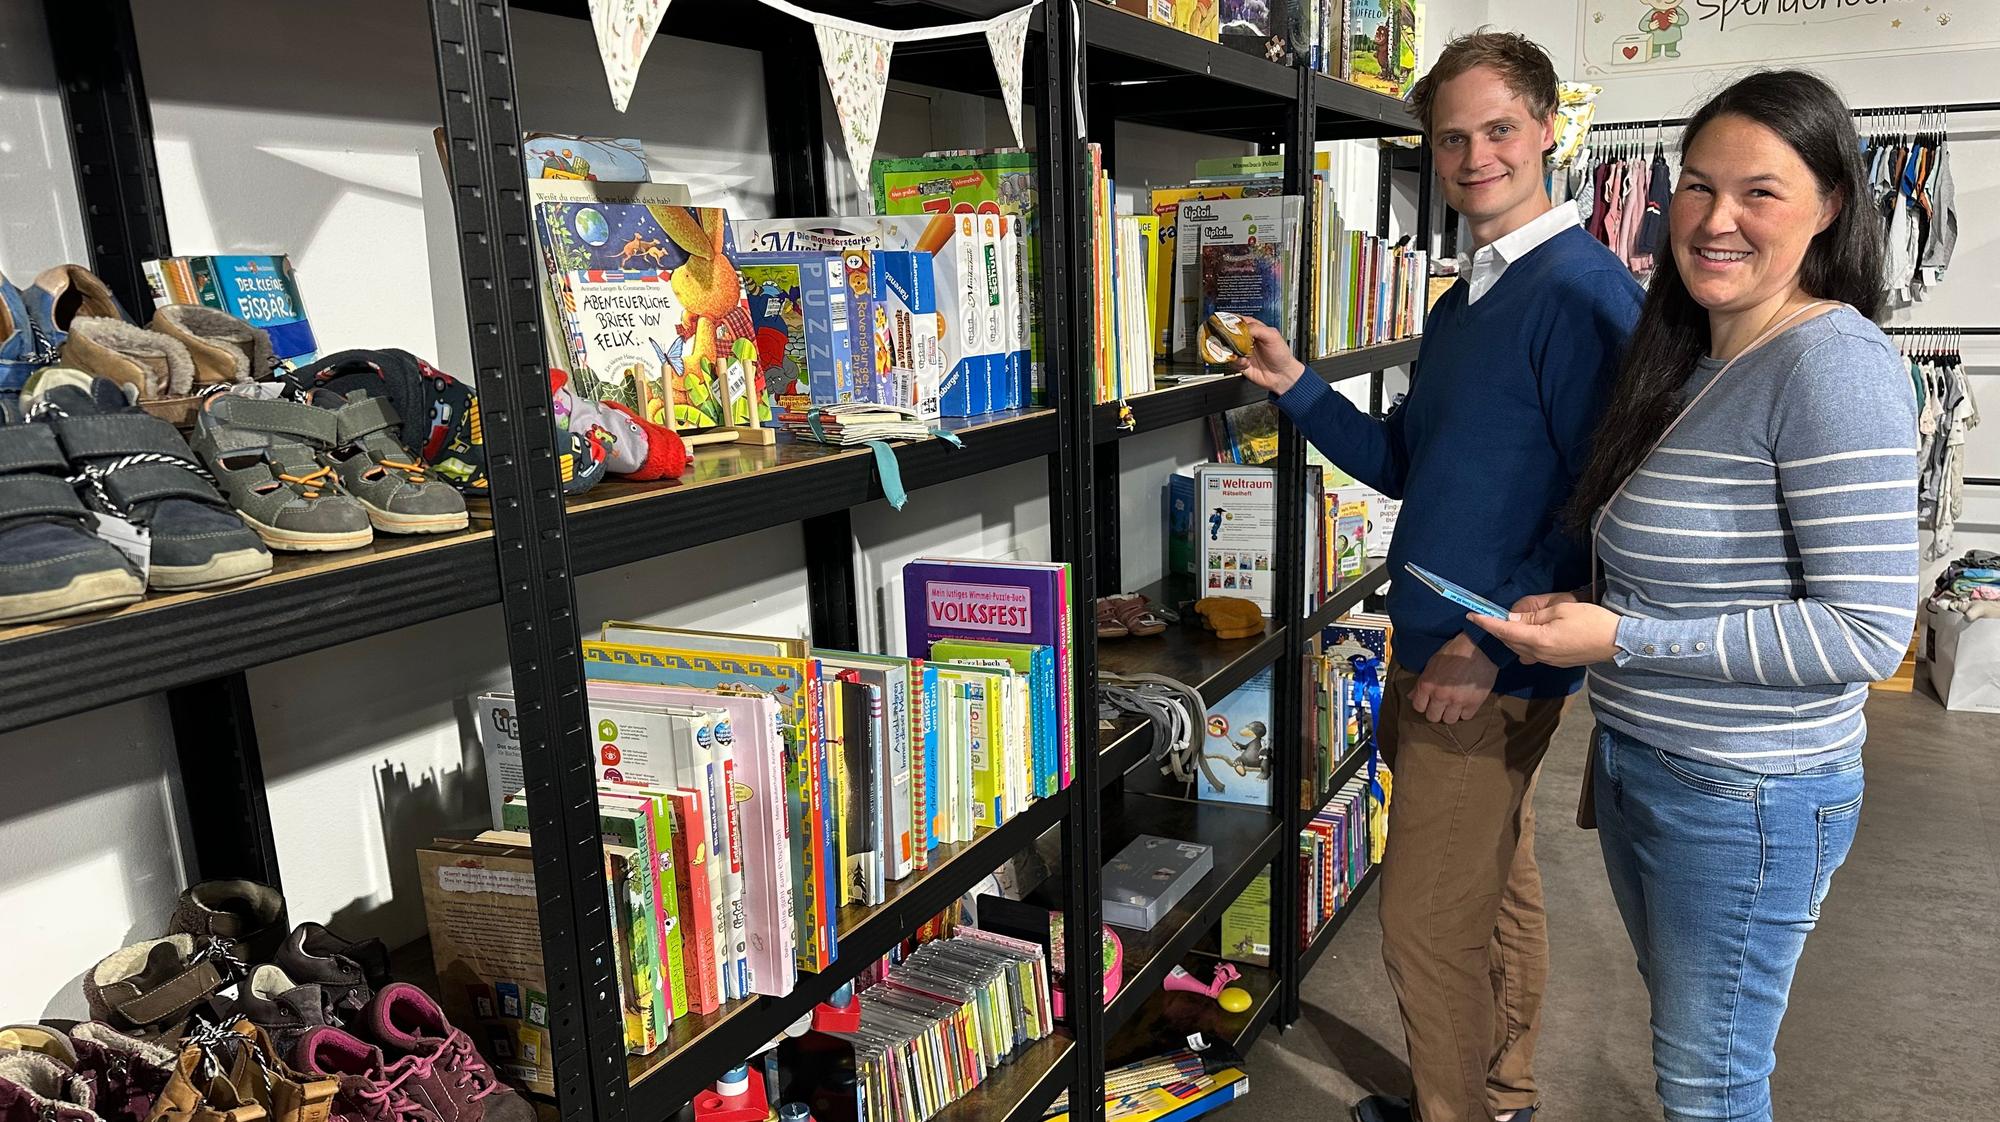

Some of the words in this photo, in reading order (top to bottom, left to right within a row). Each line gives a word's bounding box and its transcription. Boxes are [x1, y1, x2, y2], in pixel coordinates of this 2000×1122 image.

[1184, 205, 1211, 221] tiptoi
[796, 232, 810, 240] Die
[810, 235, 871, 247] monsterstarke
[1204, 226, 1227, 238] tiptoi
[988, 247, 998, 294] Schule
[234, 277, 257, 292] DER
[256, 276, 285, 291] KLEINE
[596, 312, 636, 330] BRIEFE
[639, 313, 661, 326] VON
[857, 302, 870, 387] Ravensburger
[1222, 478, 1272, 488] Weltraum
[932, 588, 946, 597] Mein
[946, 590, 968, 600] lustiges
[931, 600, 1027, 626] VOLKSFEST
[726, 768, 736, 811] Bauernhof
[779, 890, 787, 909] geht
[732, 899, 744, 929] tiptoi
